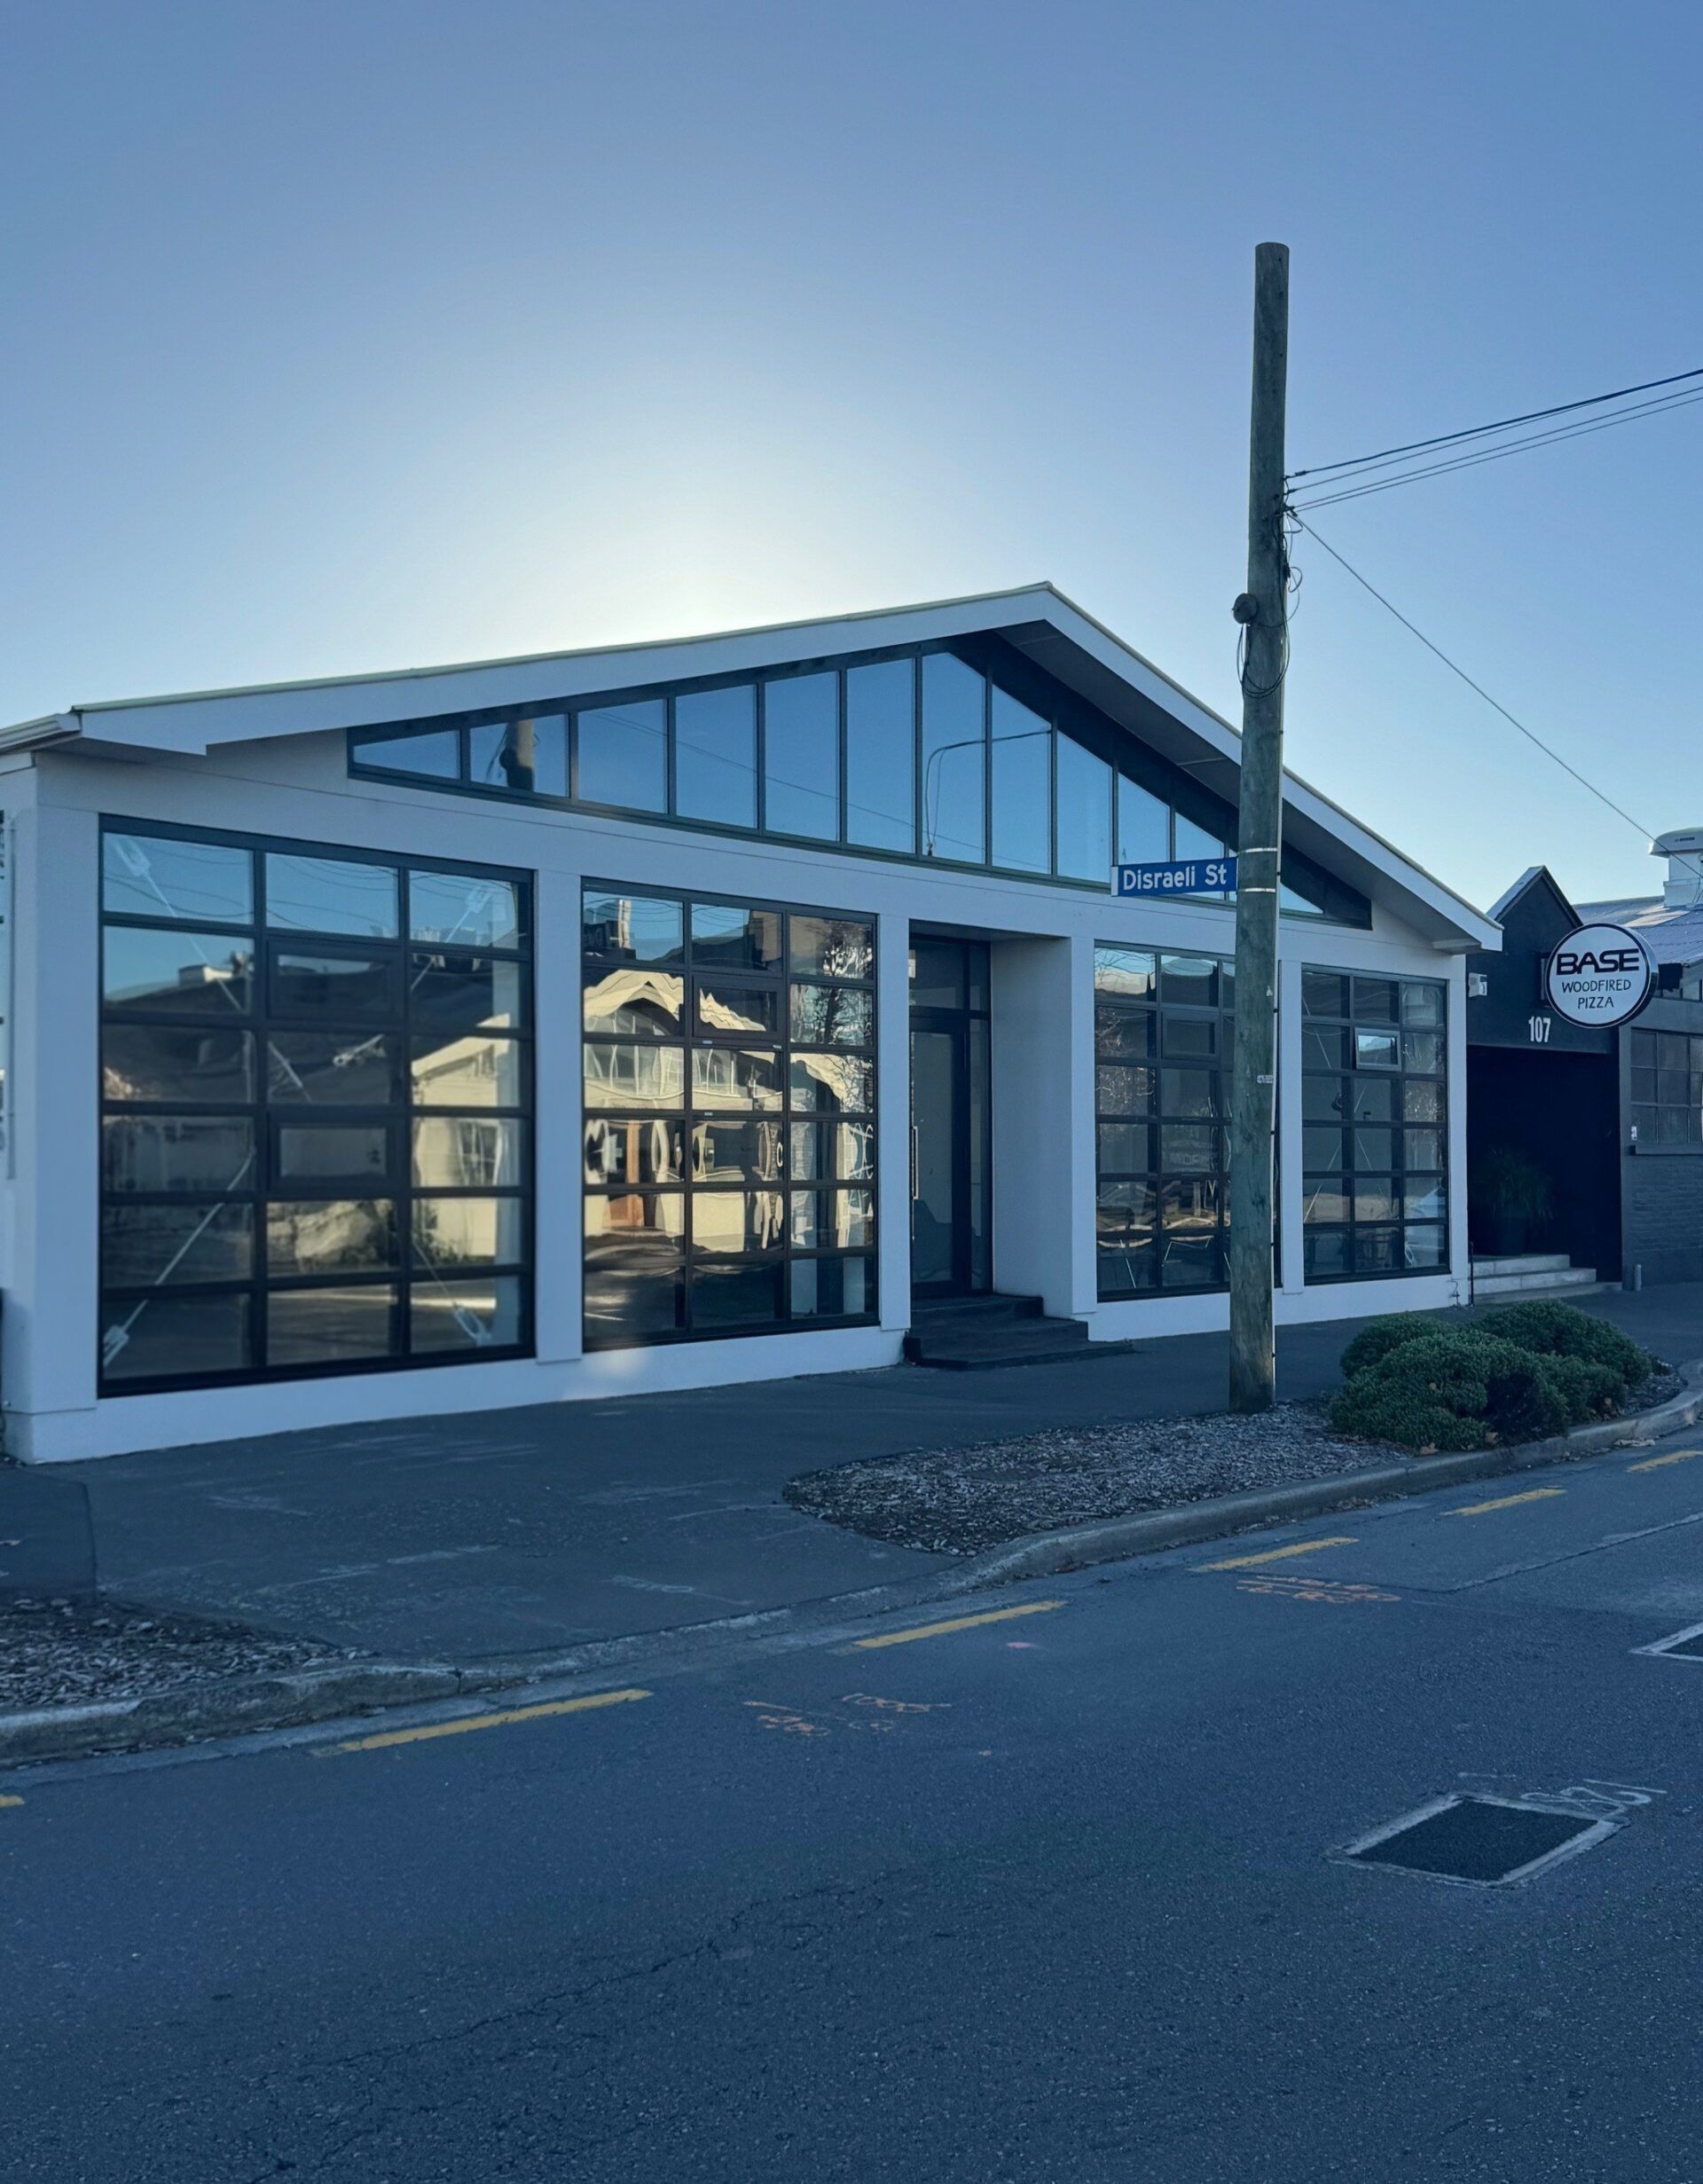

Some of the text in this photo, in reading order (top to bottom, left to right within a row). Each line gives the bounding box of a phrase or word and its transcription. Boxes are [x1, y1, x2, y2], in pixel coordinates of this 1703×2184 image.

[1123, 864, 1227, 891] Disraeli St
[1557, 948, 1639, 975] BASE
[1562, 979, 1631, 994] WOODFIRED
[1577, 997, 1614, 1010] PIZZA
[1528, 1016, 1551, 1043] 107
